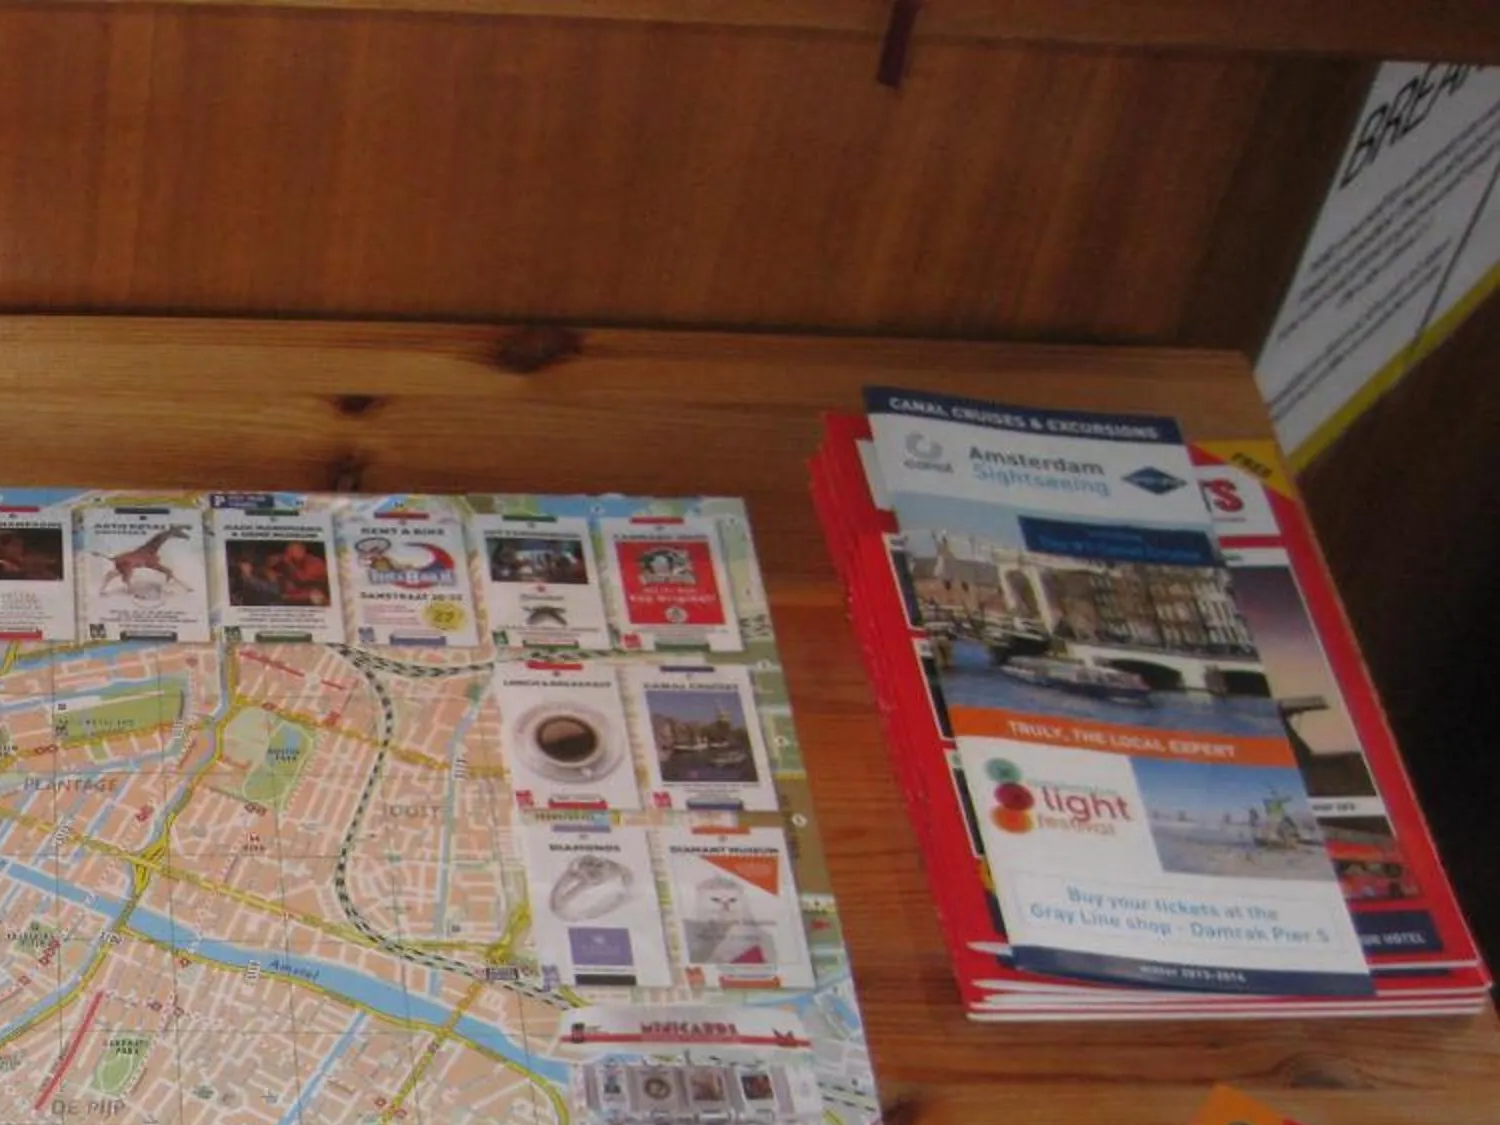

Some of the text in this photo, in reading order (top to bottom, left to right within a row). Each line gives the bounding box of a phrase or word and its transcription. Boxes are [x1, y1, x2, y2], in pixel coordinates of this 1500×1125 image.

[888, 397, 949, 418] CANAL
[952, 407, 1027, 430] CRUISES
[1046, 418, 1160, 441] EXCURSIONS
[969, 446, 1106, 476] Amsterdam
[972, 462, 1112, 498] Sightseeing
[360, 527, 398, 536] RENT
[413, 527, 445, 537] BIKE
[1072, 726, 1106, 746] THE
[1109, 730, 1163, 752] LOCAL
[1169, 735, 1238, 759] EXPERT
[23, 777, 117, 793] PLANTAGE
[1042, 784, 1134, 823] light
[1066, 885, 1279, 921] Buy your tickets at the
[1029, 902, 1077, 927] Gray
[1080, 909, 1120, 929] Line
[1126, 913, 1173, 937] shop
[1190, 919, 1269, 942] Damrak
[1272, 924, 1311, 943] Pier
[268, 957, 322, 980] Amstel
[640, 1022, 739, 1036] MINICARDS
[51, 1100, 126, 1117] DE PIJP
